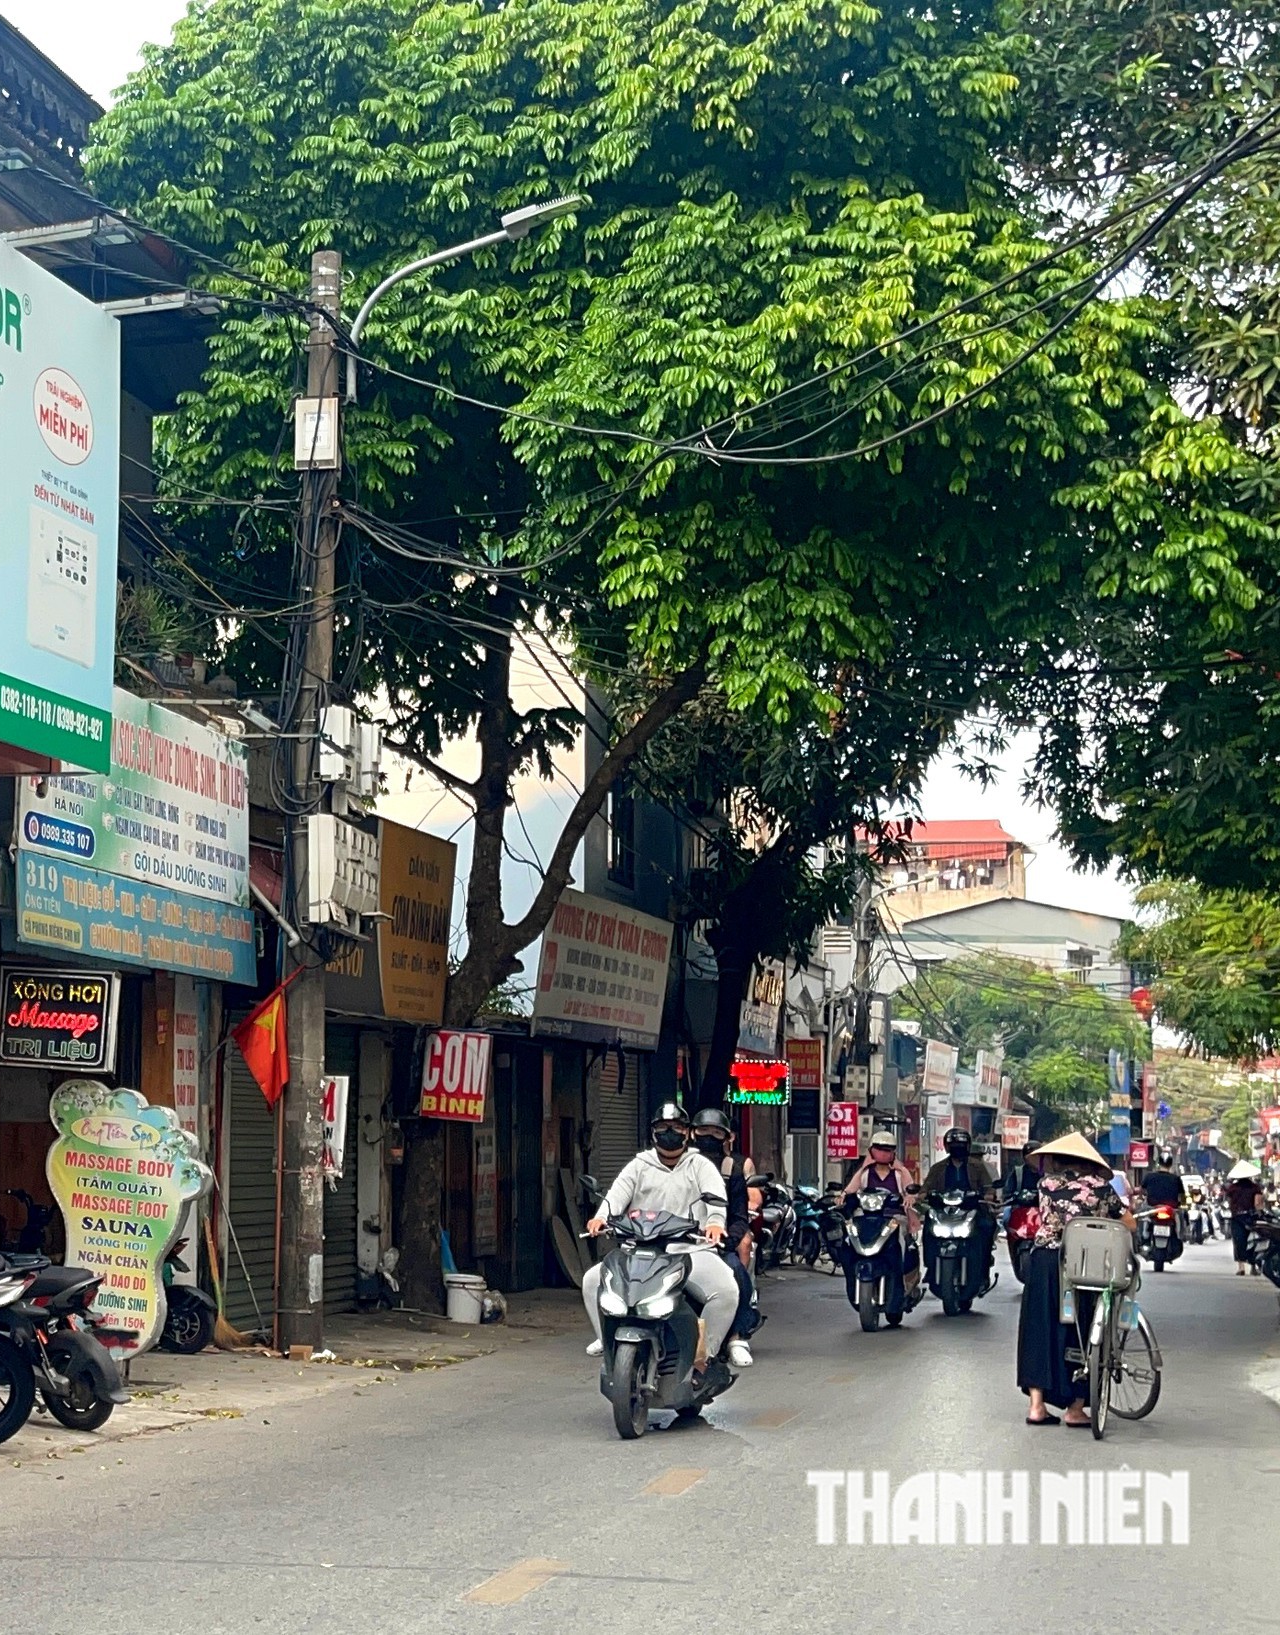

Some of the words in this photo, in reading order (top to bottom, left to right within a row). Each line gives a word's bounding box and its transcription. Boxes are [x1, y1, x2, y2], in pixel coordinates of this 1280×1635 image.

[39, 402, 67, 440] MIỄN
[70, 425, 88, 451] PHÍ
[0, 685, 52, 725] 0382-118-118
[77, 833, 90, 850] 107
[26, 860, 58, 893] 319
[134, 850, 151, 877] GỘI
[153, 854, 173, 879] ĐẦU
[175, 864, 206, 888] DƯỠNG
[207, 874, 227, 894] SINH
[24, 890, 43, 909] ÔNG
[12, 978, 64, 1000] XÔNG
[69, 984, 102, 1003] HƠI
[8, 1000, 99, 1038] Massage
[6, 1037, 42, 1058] TRỊ
[47, 1038, 97, 1060] LIỆU
[422, 1033, 490, 1095] CƠM
[422, 1093, 484, 1116] BÌNH
[829, 1104, 853, 1122] ÔI
[65, 1151, 133, 1174] MASSAGE
[137, 1160, 174, 1179] BODY
[71, 1192, 133, 1215] MASSAGE
[136, 1201, 169, 1219] FOOT
[81, 1216, 153, 1238] SAUNA
[77, 1250, 112, 1266] NGÂM
[115, 1255, 149, 1270] CHÂN
[111, 1274, 130, 1290] DAO
[98, 1291, 126, 1309] DƯỠNG
[127, 1299, 148, 1313] SINH
[123, 1317, 145, 1330] 150k
